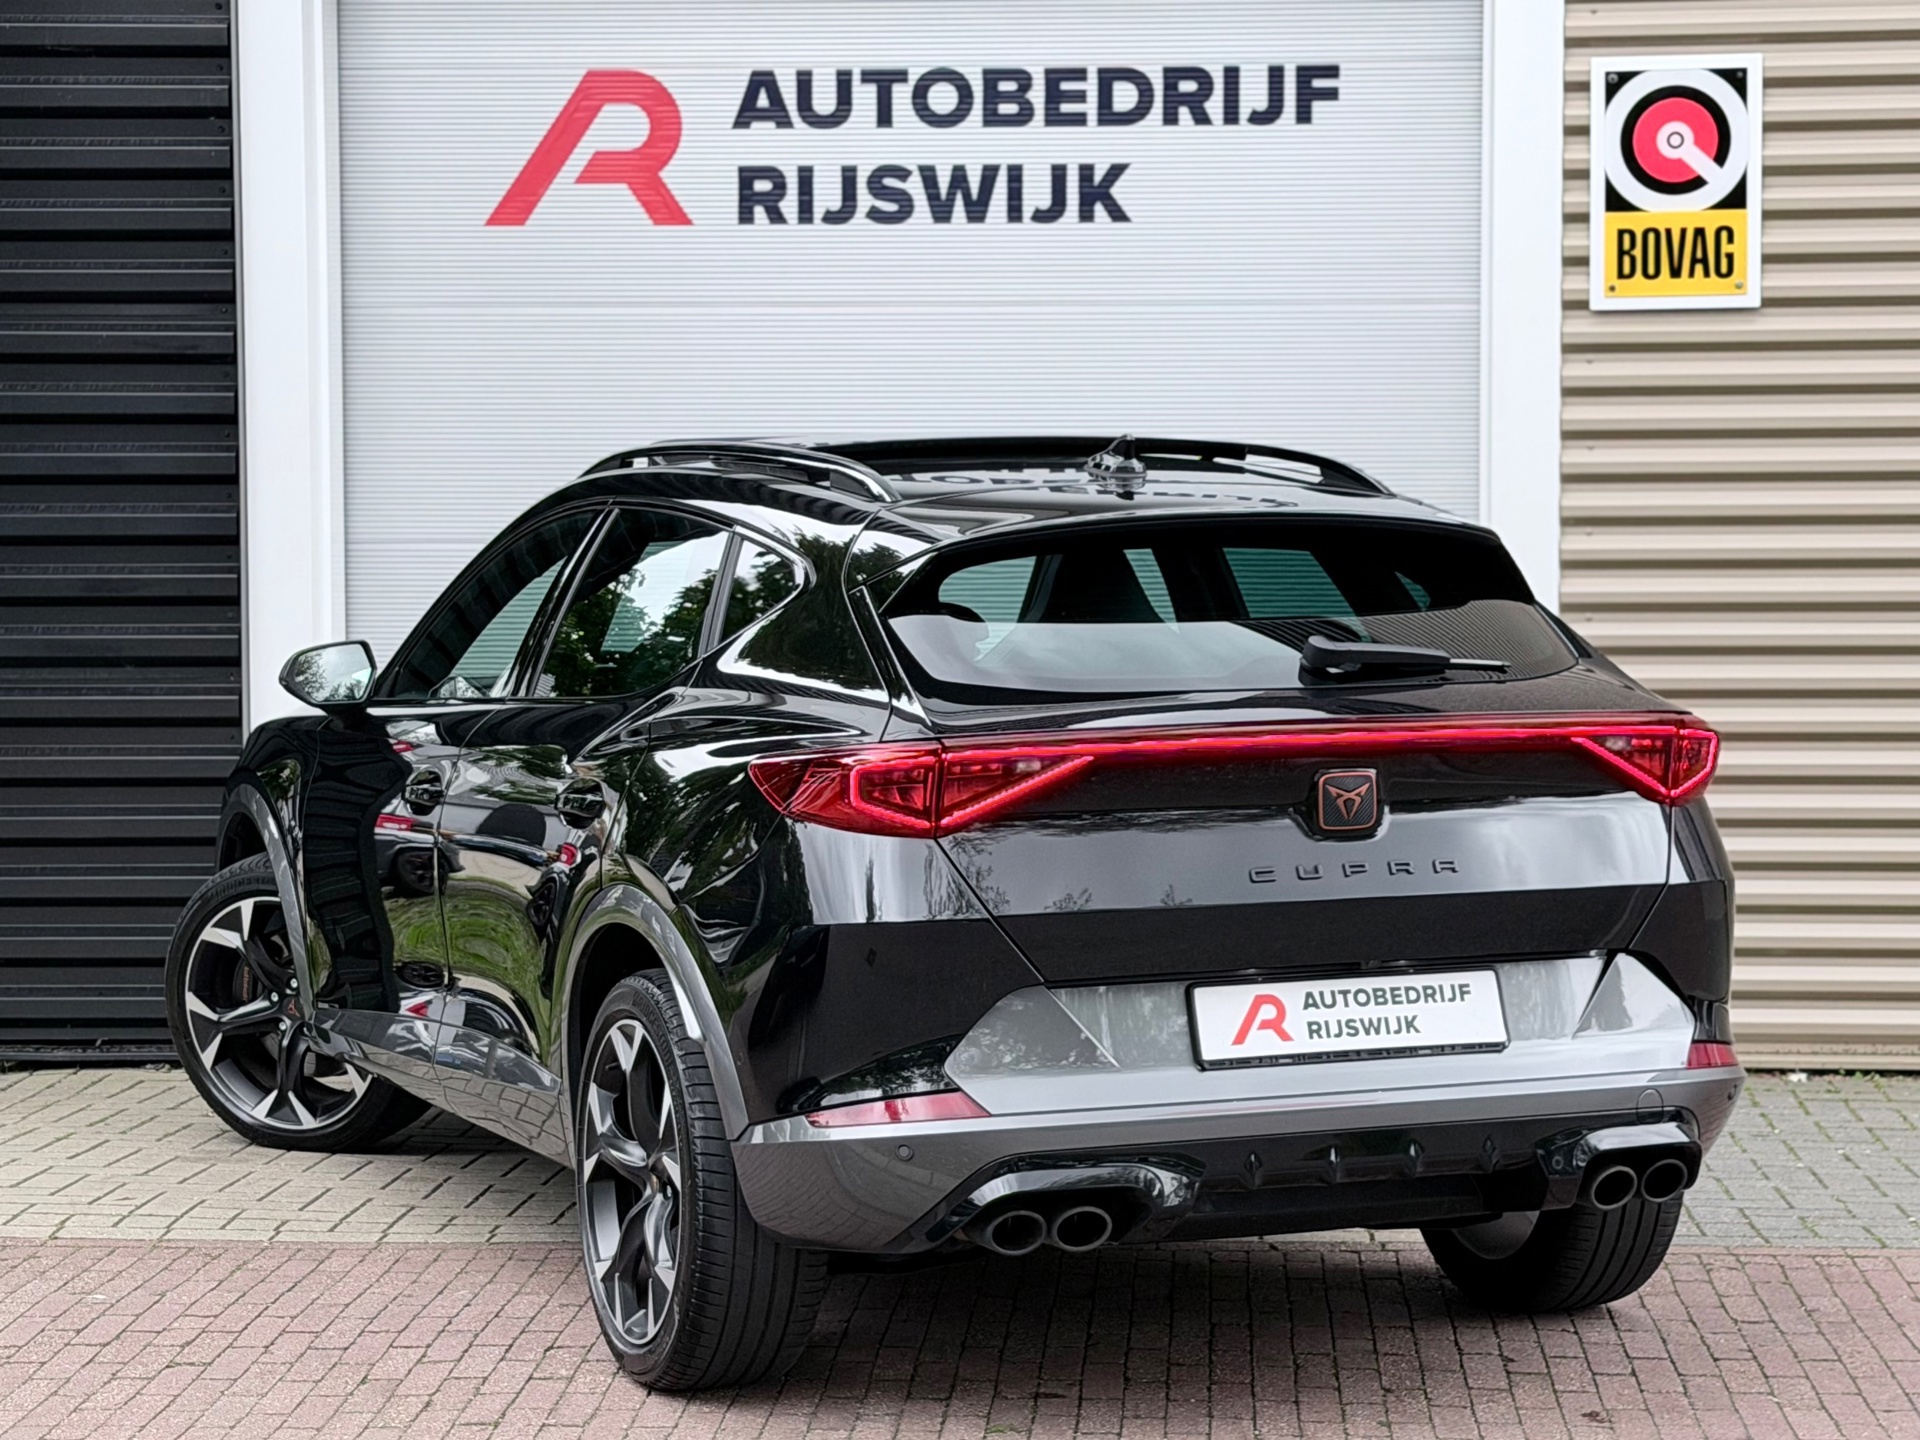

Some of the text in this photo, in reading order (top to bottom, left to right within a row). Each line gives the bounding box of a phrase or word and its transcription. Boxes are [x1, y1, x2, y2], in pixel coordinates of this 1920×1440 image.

[732, 65, 1341, 129] AUTOBEDRIJF
[737, 163, 1131, 225] RIJSWIJK
[1616, 225, 1735, 280] BOVAG
[1249, 858, 1459, 884] CUPRA
[1302, 983, 1472, 1011] AUTOBEDRIJF
[1306, 1015, 1421, 1040] RIJSWIJK
